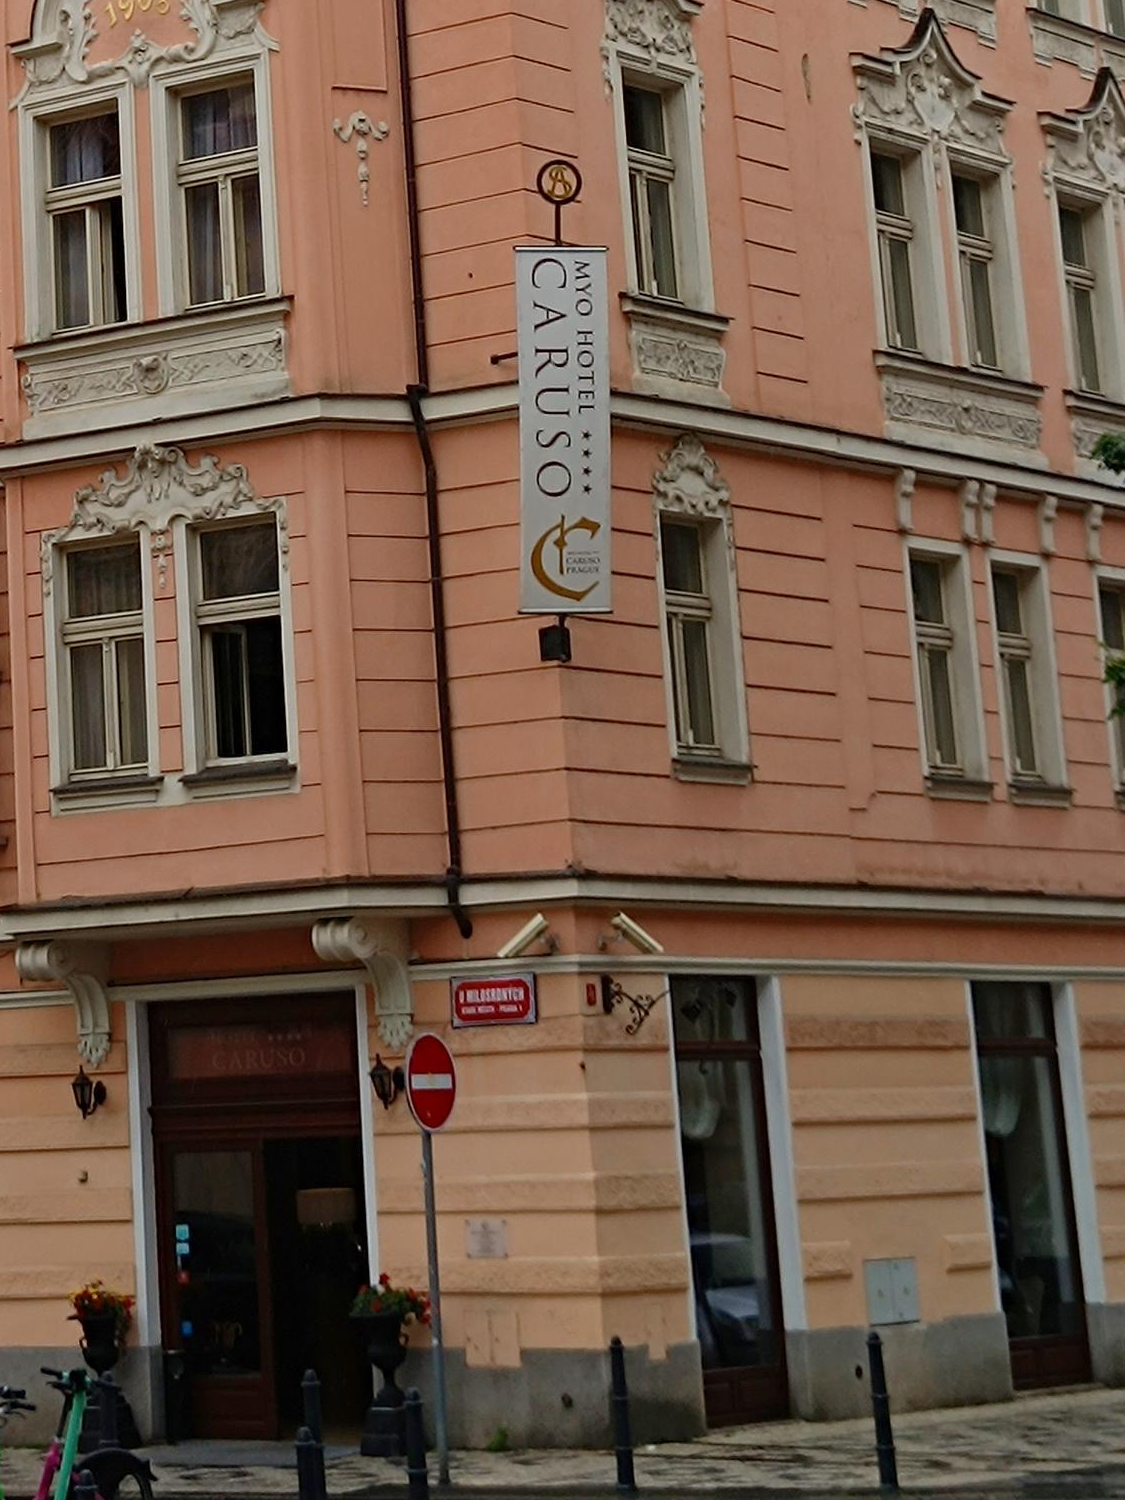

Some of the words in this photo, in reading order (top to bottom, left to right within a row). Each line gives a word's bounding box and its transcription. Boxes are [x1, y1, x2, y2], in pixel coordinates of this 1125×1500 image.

[574, 260, 593, 318] MYO
[531, 257, 573, 498] CARUSO
[576, 330, 596, 414] HOTEL
[212, 1047, 306, 1070] CARUSO
